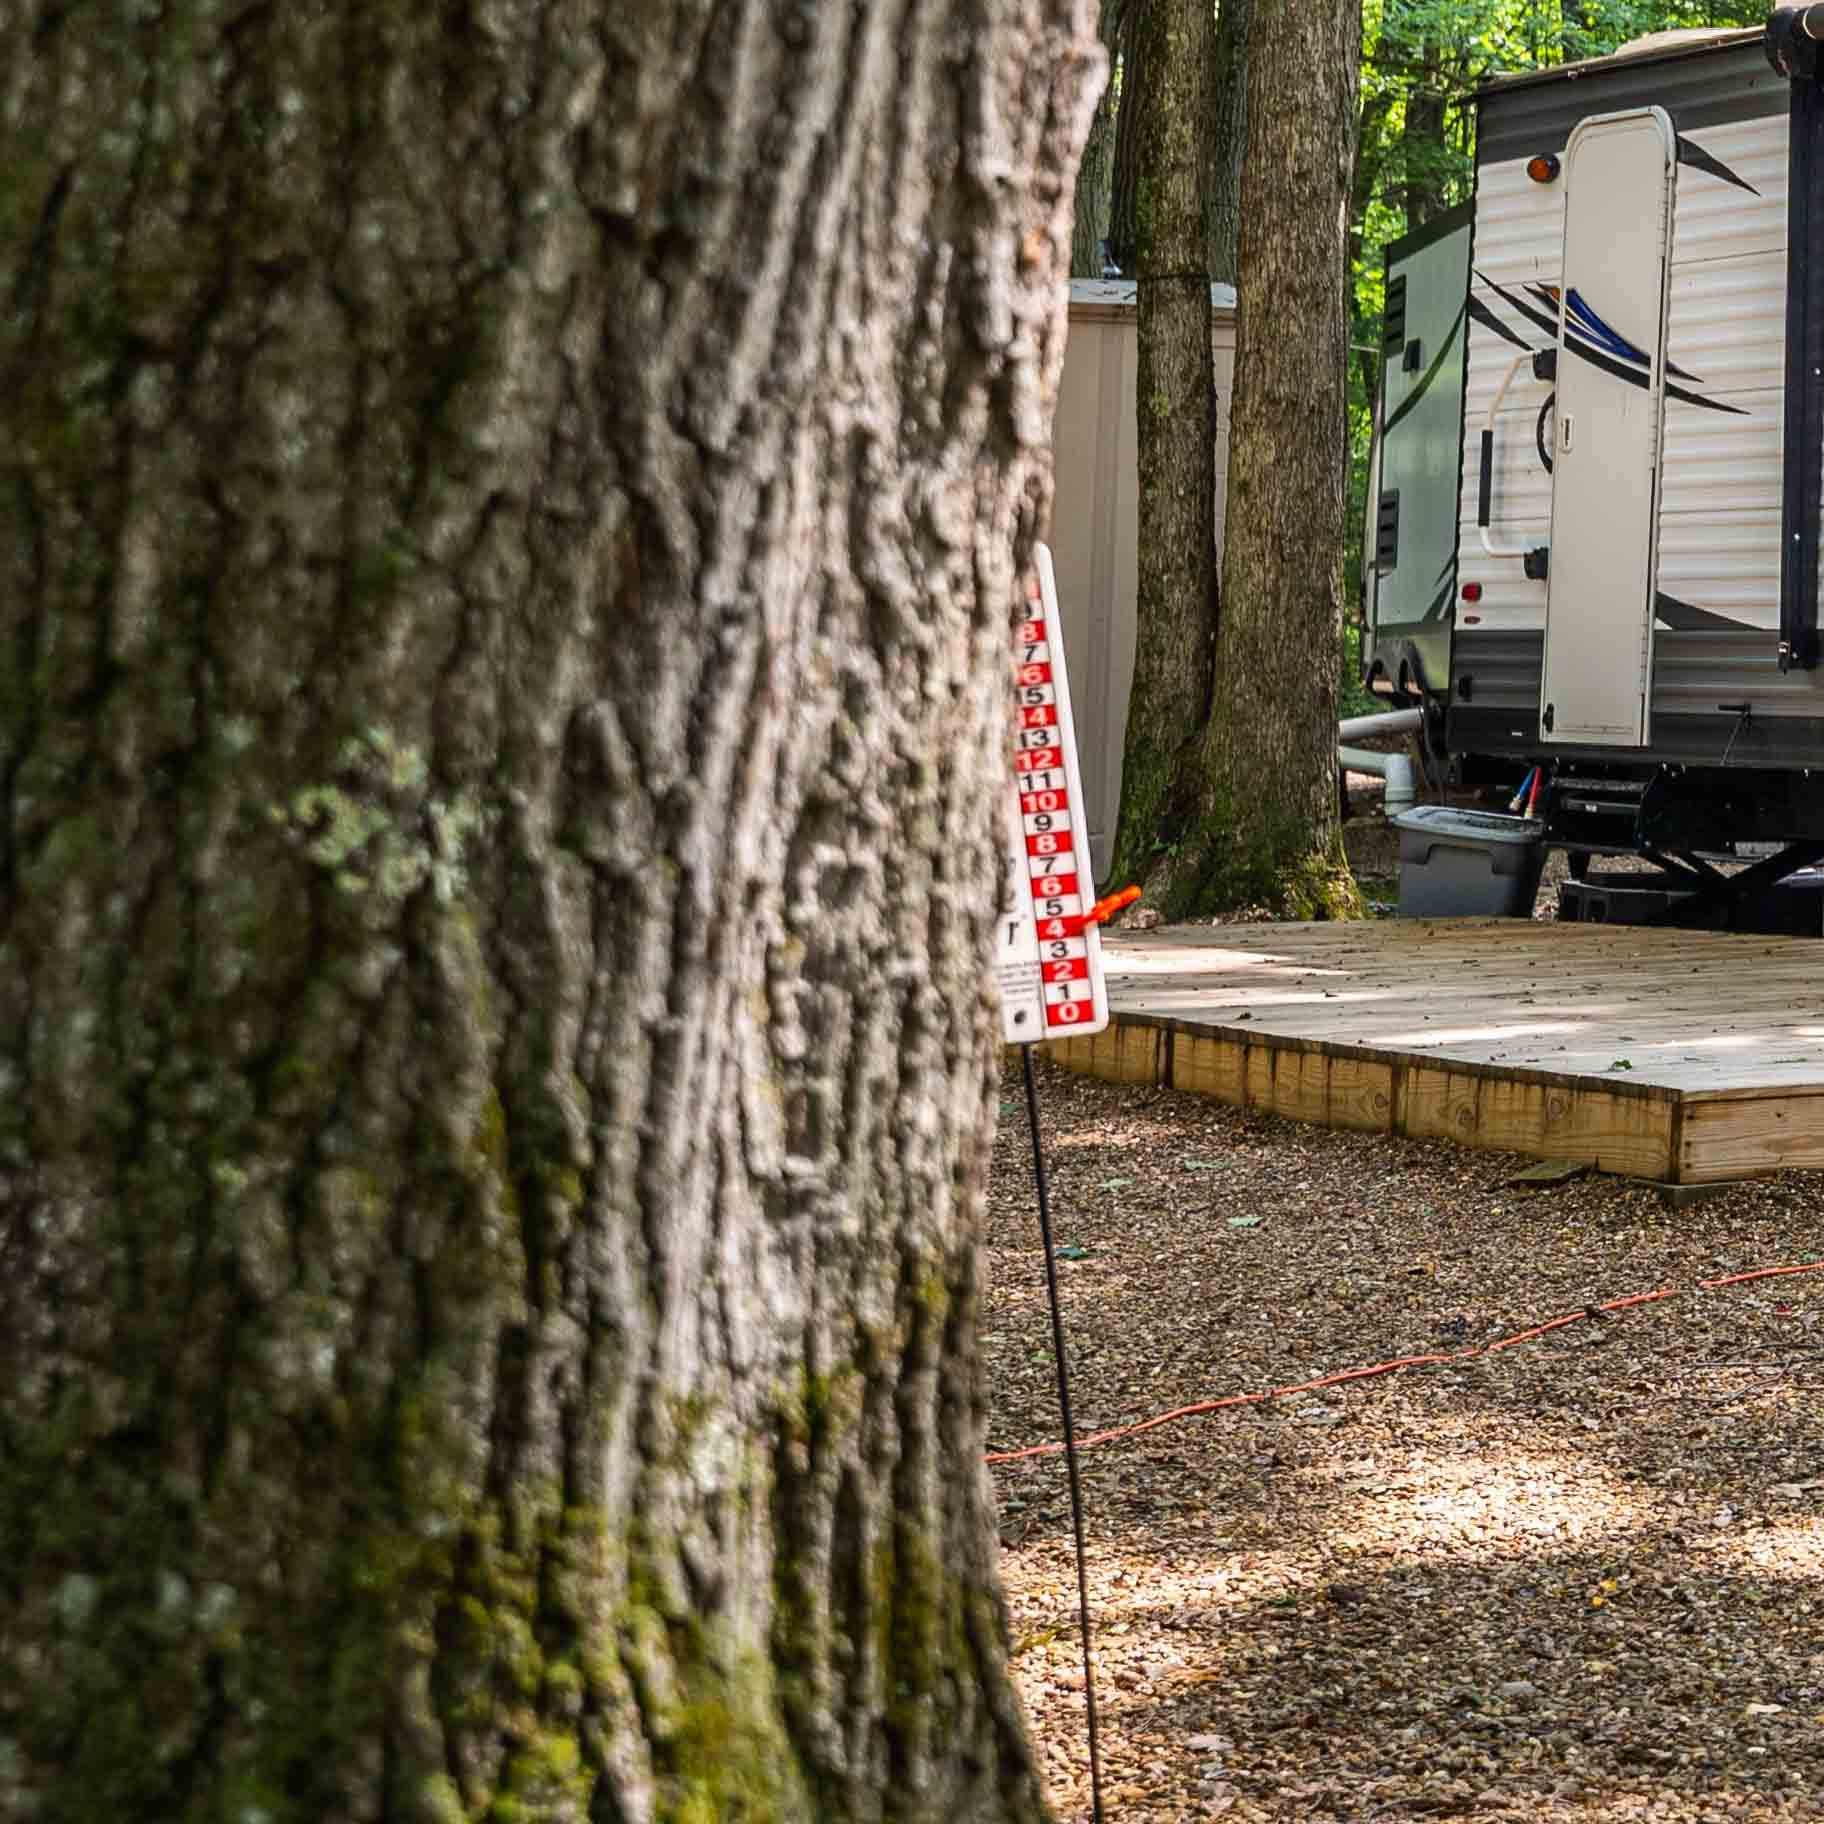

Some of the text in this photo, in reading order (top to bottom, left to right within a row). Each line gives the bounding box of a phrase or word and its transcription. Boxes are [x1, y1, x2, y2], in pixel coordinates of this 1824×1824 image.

[1020, 729, 1050, 748] 13
[1017, 751, 1054, 771] 12
[1022, 773, 1051, 791] 11
[1023, 792, 1057, 812] 10
[1034, 814, 1053, 832] 9
[1036, 835, 1057, 853] 8
[1040, 857, 1058, 873] 7
[1040, 878, 1062, 897] 6
[1045, 899, 1063, 916] 5
[1045, 919, 1065, 936] 4
[1051, 941, 1069, 958] 3
[1053, 962, 1073, 980] 2
[1058, 983, 1069, 999] 1
[1058, 1003, 1080, 1023] 0
